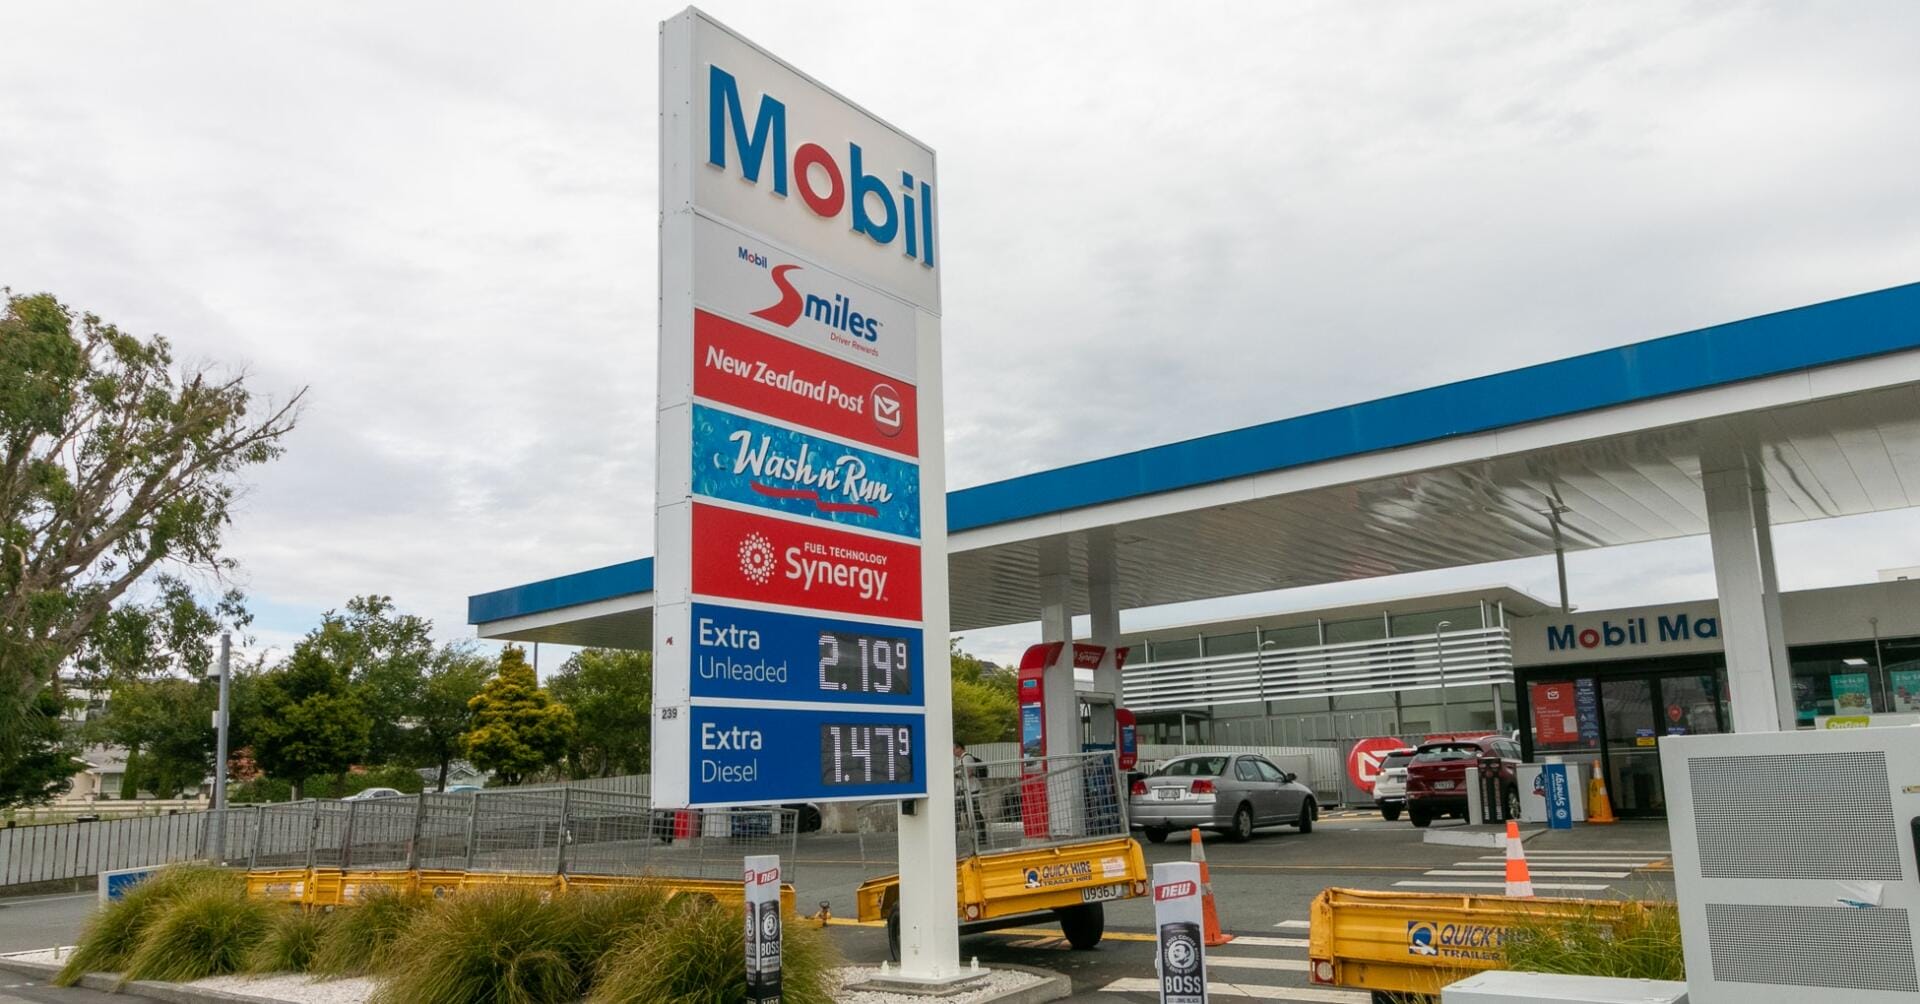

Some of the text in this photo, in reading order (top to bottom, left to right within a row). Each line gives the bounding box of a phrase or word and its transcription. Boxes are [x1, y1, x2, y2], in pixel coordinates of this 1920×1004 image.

[708, 63, 934, 268] Mobil
[738, 246, 767, 268] Mobil
[749, 264, 878, 343] Smiles
[830, 332, 879, 357] Driver Rewards
[705, 346, 864, 414] New Zealand Post
[729, 430, 819, 483] Wash
[836, 455, 893, 504] Run
[804, 542, 887, 565] FUEL TECHNOLOGY
[785, 547, 888, 600] Synergy
[699, 618, 760, 650] Extra
[1547, 618, 1647, 650] Mobil
[699, 656, 787, 683] Unleaded
[662, 709, 678, 720] 239
[702, 722, 762, 750] Extra
[702, 758, 757, 783] Diesel
[1556, 772, 1565, 806] Synergy
[761, 870, 777, 883] NEW
[1042, 864, 1069, 878] QUICK
[1071, 861, 1092, 874] HIRE
[1042, 878, 1074, 886] TRAILER
[1161, 882, 1191, 899] NEW
[1440, 924, 1494, 947] QUICK
[761, 941, 779, 956] BOSS
[1443, 949, 1500, 960] TRAILER
[1165, 976, 1202, 993] BOSS
